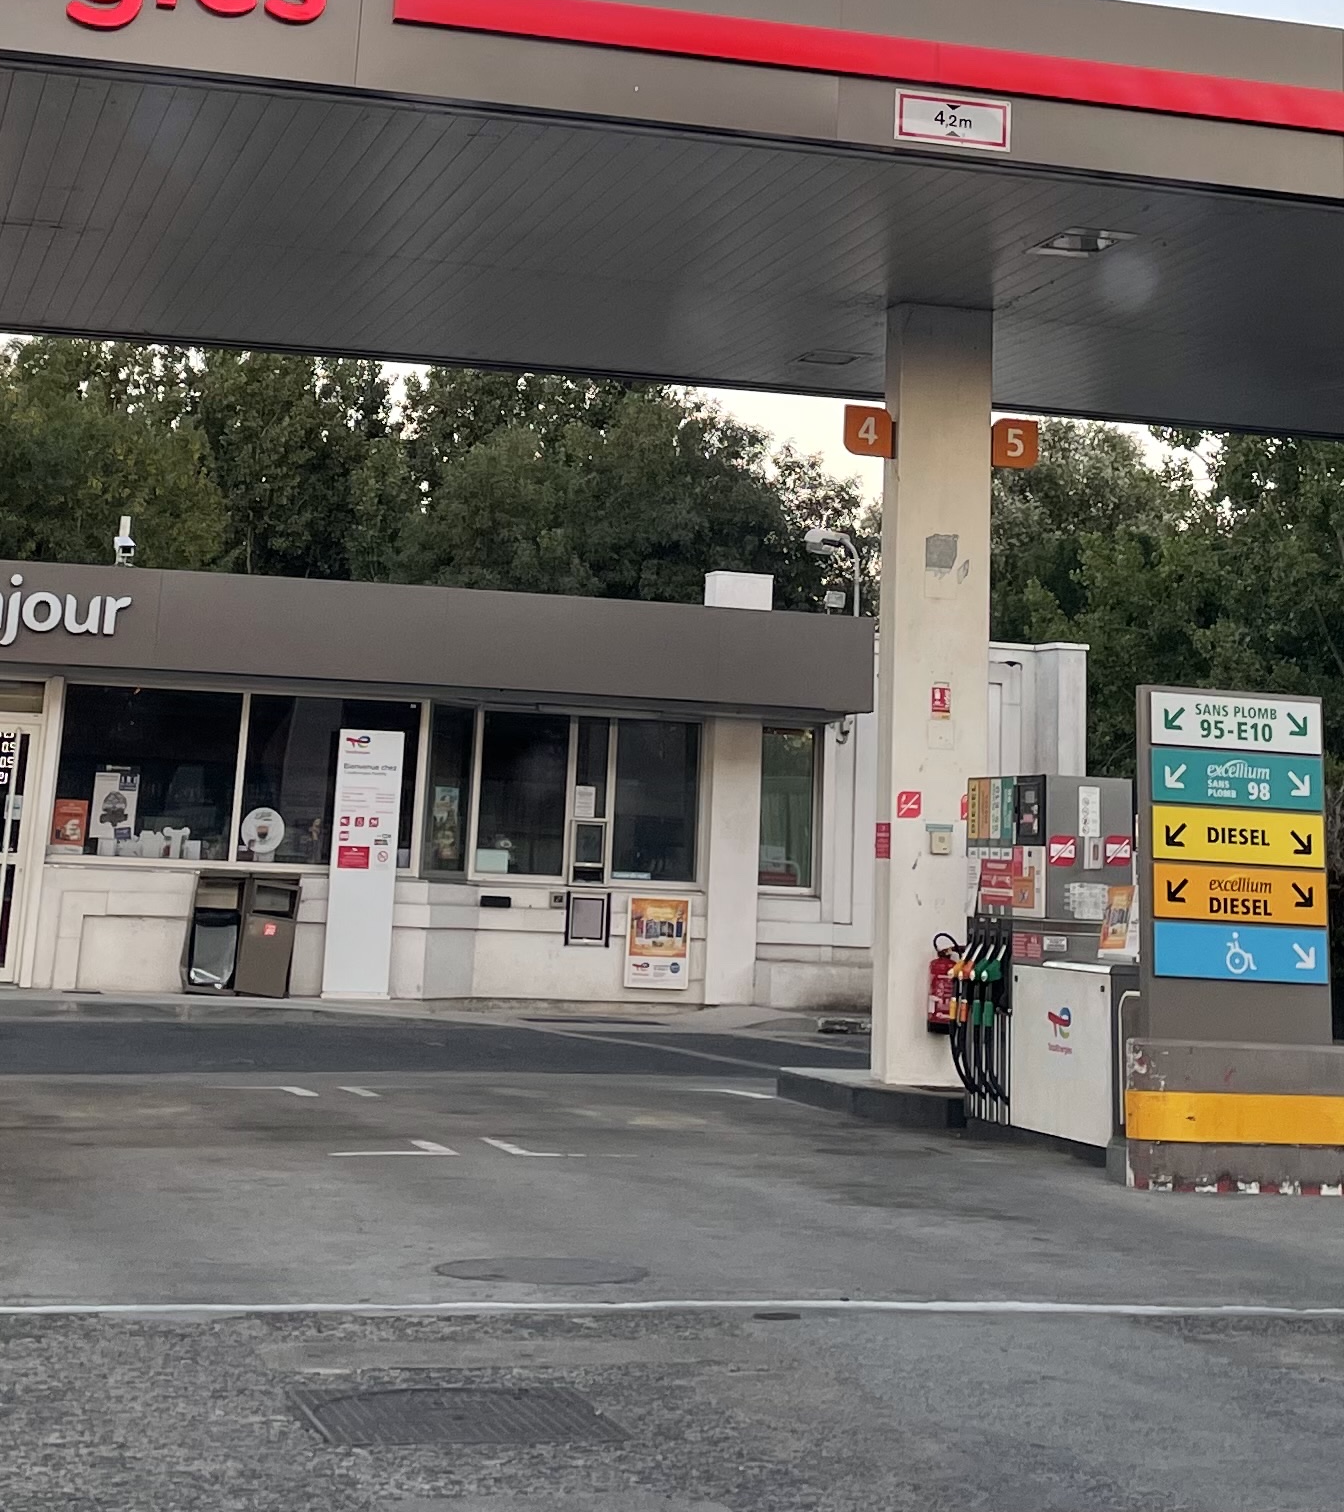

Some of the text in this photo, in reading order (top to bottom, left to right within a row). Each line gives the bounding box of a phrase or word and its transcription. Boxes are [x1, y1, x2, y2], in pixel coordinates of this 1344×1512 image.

[858, 417, 878, 445] 4
[1006, 428, 1024, 457] 5
[1195, 703, 1277, 720] SANS PLOMB
[1200, 719, 1273, 742] 95-E10
[1207, 761, 1270, 780] excellium
[1207, 779, 1229, 788] SANS
[1207, 782, 1271, 801] PLOMB 98
[1207, 827, 1270, 846] DIESEL
[1209, 877, 1272, 894] excellium
[1209, 897, 1273, 917] DIESEL
